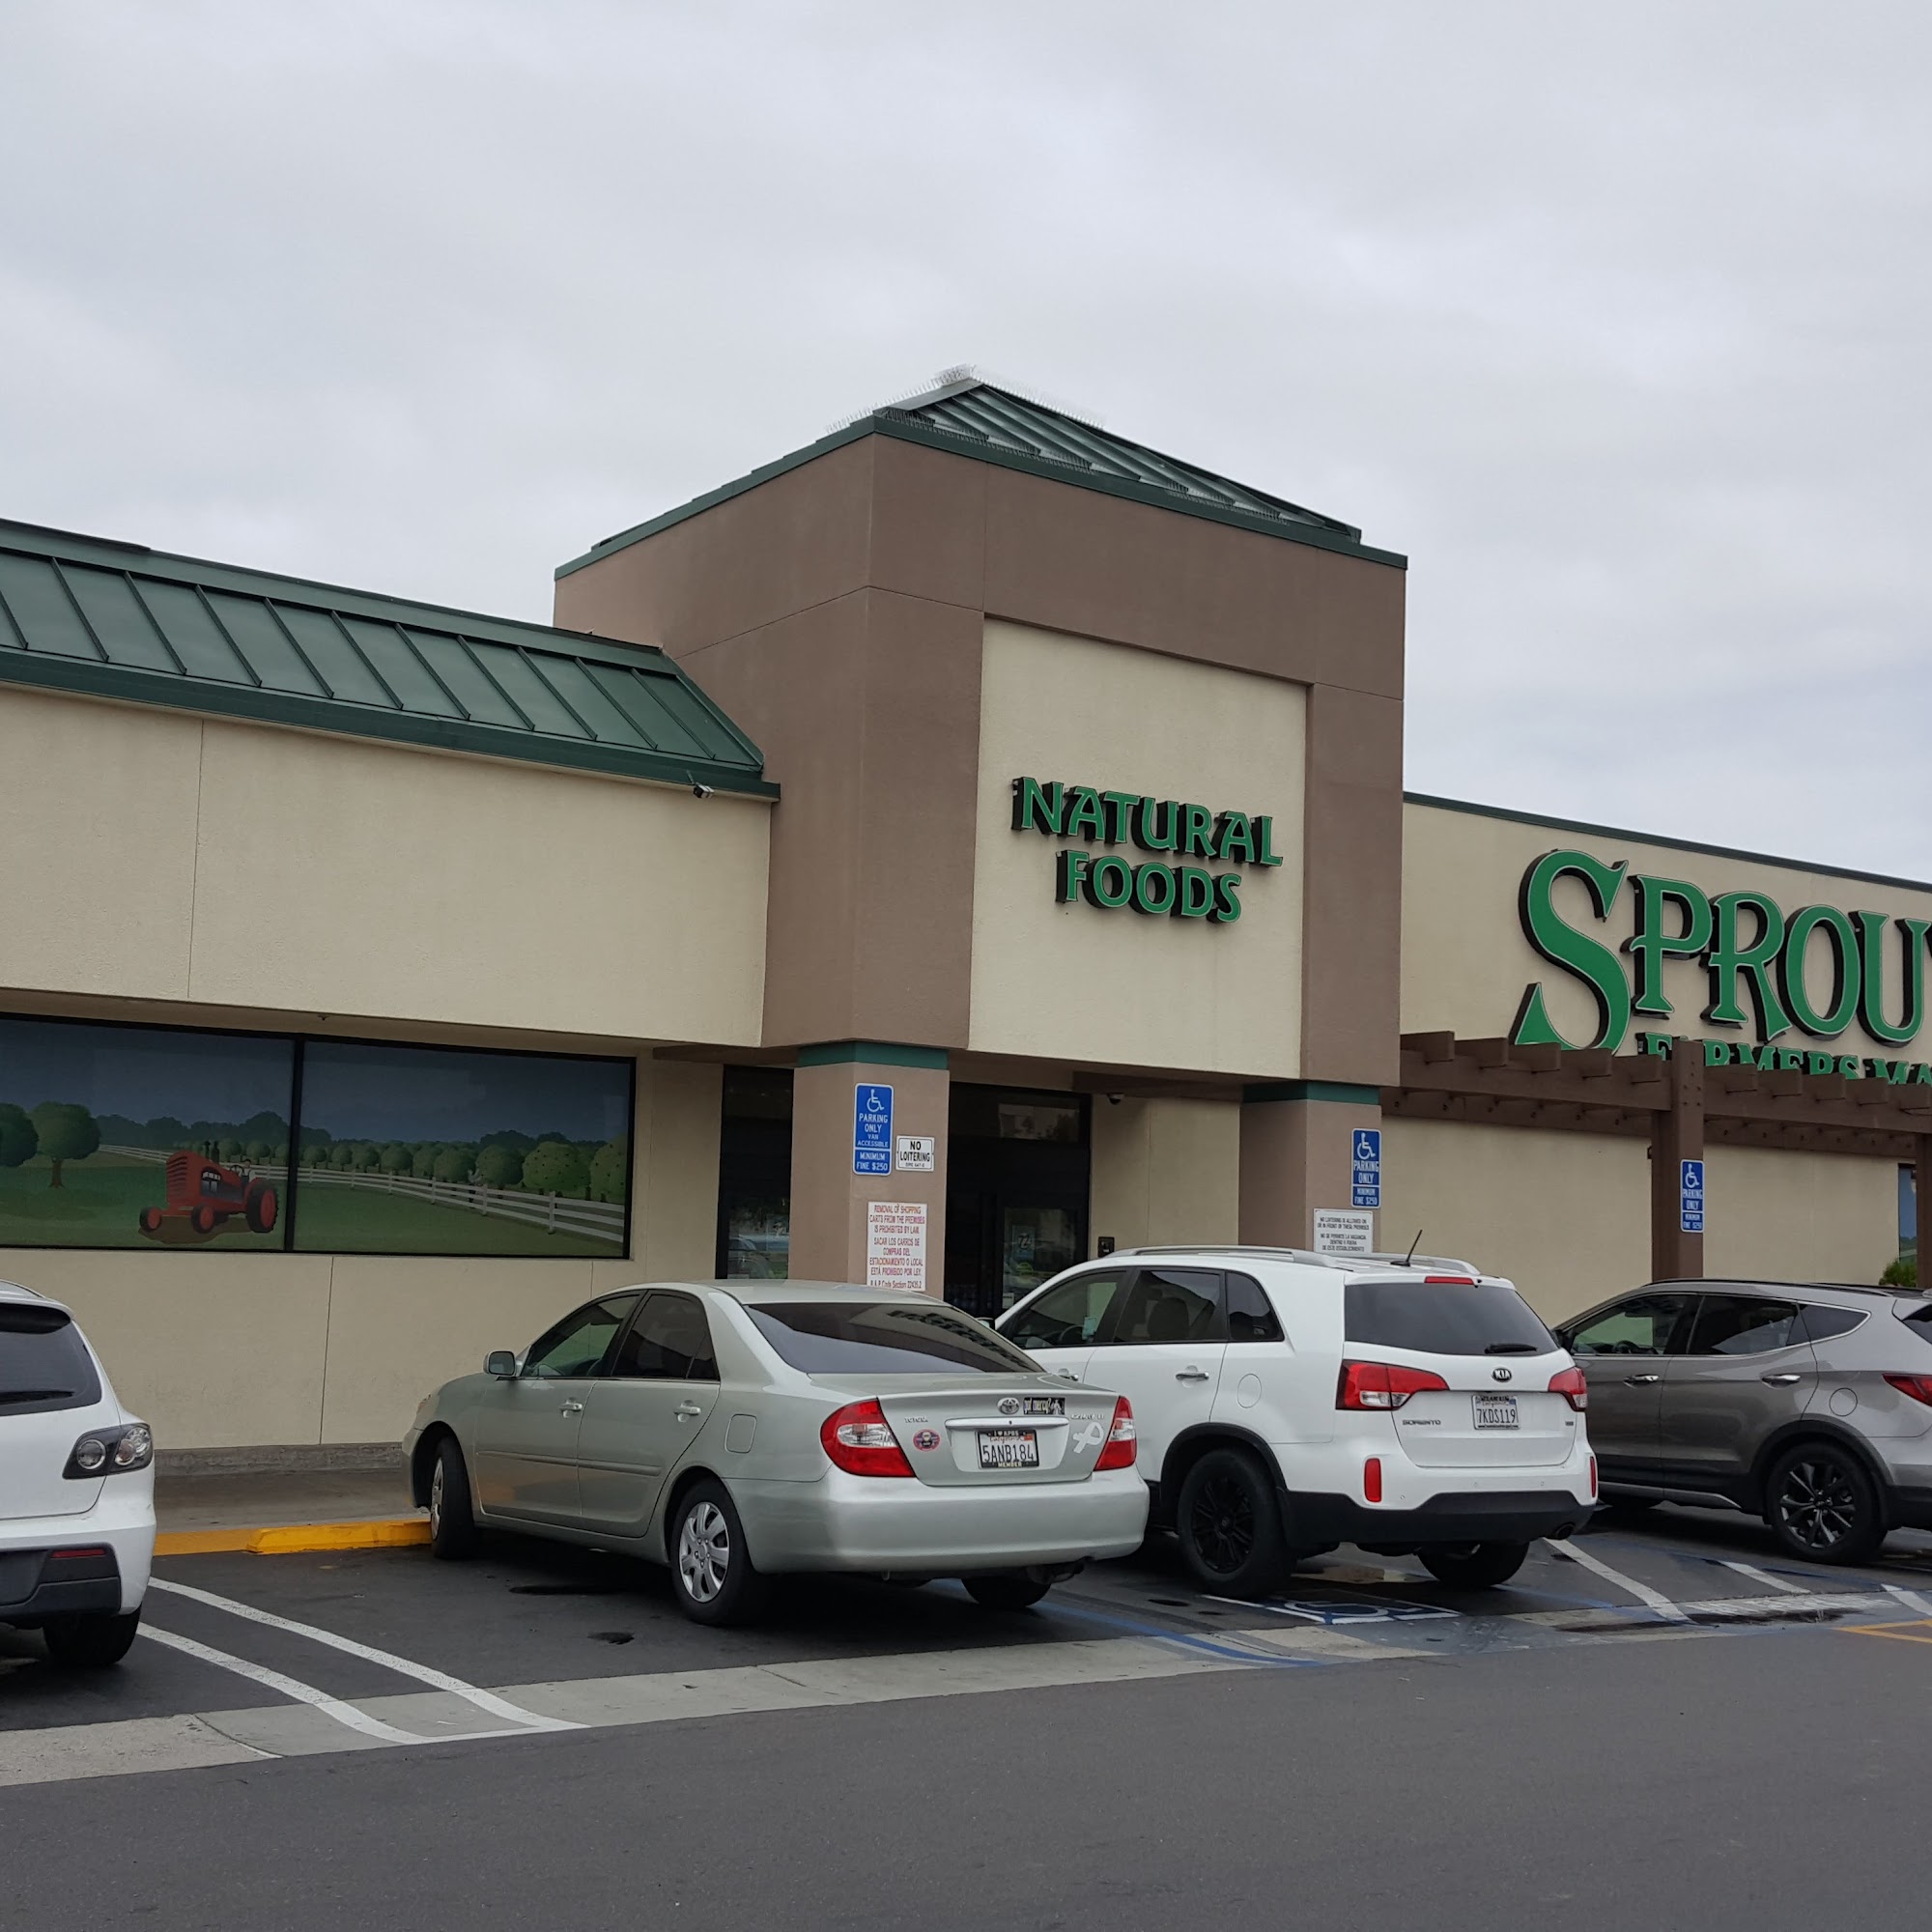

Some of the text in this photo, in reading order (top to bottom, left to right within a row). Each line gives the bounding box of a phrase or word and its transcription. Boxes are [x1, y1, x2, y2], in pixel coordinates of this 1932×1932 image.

[1012, 777, 1283, 867] NATURAL
[1056, 850, 1241, 923] FOODS
[1510, 849, 1932, 1056] SPROU
[1636, 1032, 1859, 1080] FRMERS
[859, 1113, 889, 1123] PARKING
[865, 1123, 882, 1133] ONLY
[910, 1141, 922, 1151] NO
[860, 1151, 886, 1160] MINIMUM
[899, 1151, 930, 1162] LOITERING
[856, 1161, 889, 1171] FINE $250
[1353, 1159, 1379, 1173] PARKING
[1358, 1173, 1375, 1184] ONLY
[1683, 1188, 1703, 1199] PARKING
[874, 1205, 922, 1214] REMOVAL OF SHOPPING
[1687, 1200, 1699, 1209] ONLY
[869, 1214, 883, 1223] CARTS
[884, 1215, 895, 1224] FROM
[879, 1225, 903, 1234] PROHIBITED
[897, 1237, 914, 1246] CARROS
[883, 1247, 902, 1256] COMPRAS
[869, 1257, 905, 1265] ESTACIONAMIENTO
[910, 1258, 923, 1266] LOCAL
[882, 1266, 903, 1276] PROHIBIDO
[904, 1267, 913, 1276] POR
[1493, 1369, 1510, 1379] KIA
[1476, 1408, 1516, 1424] 7KDS119
[981, 1444, 1034, 1463] 5ANB184
